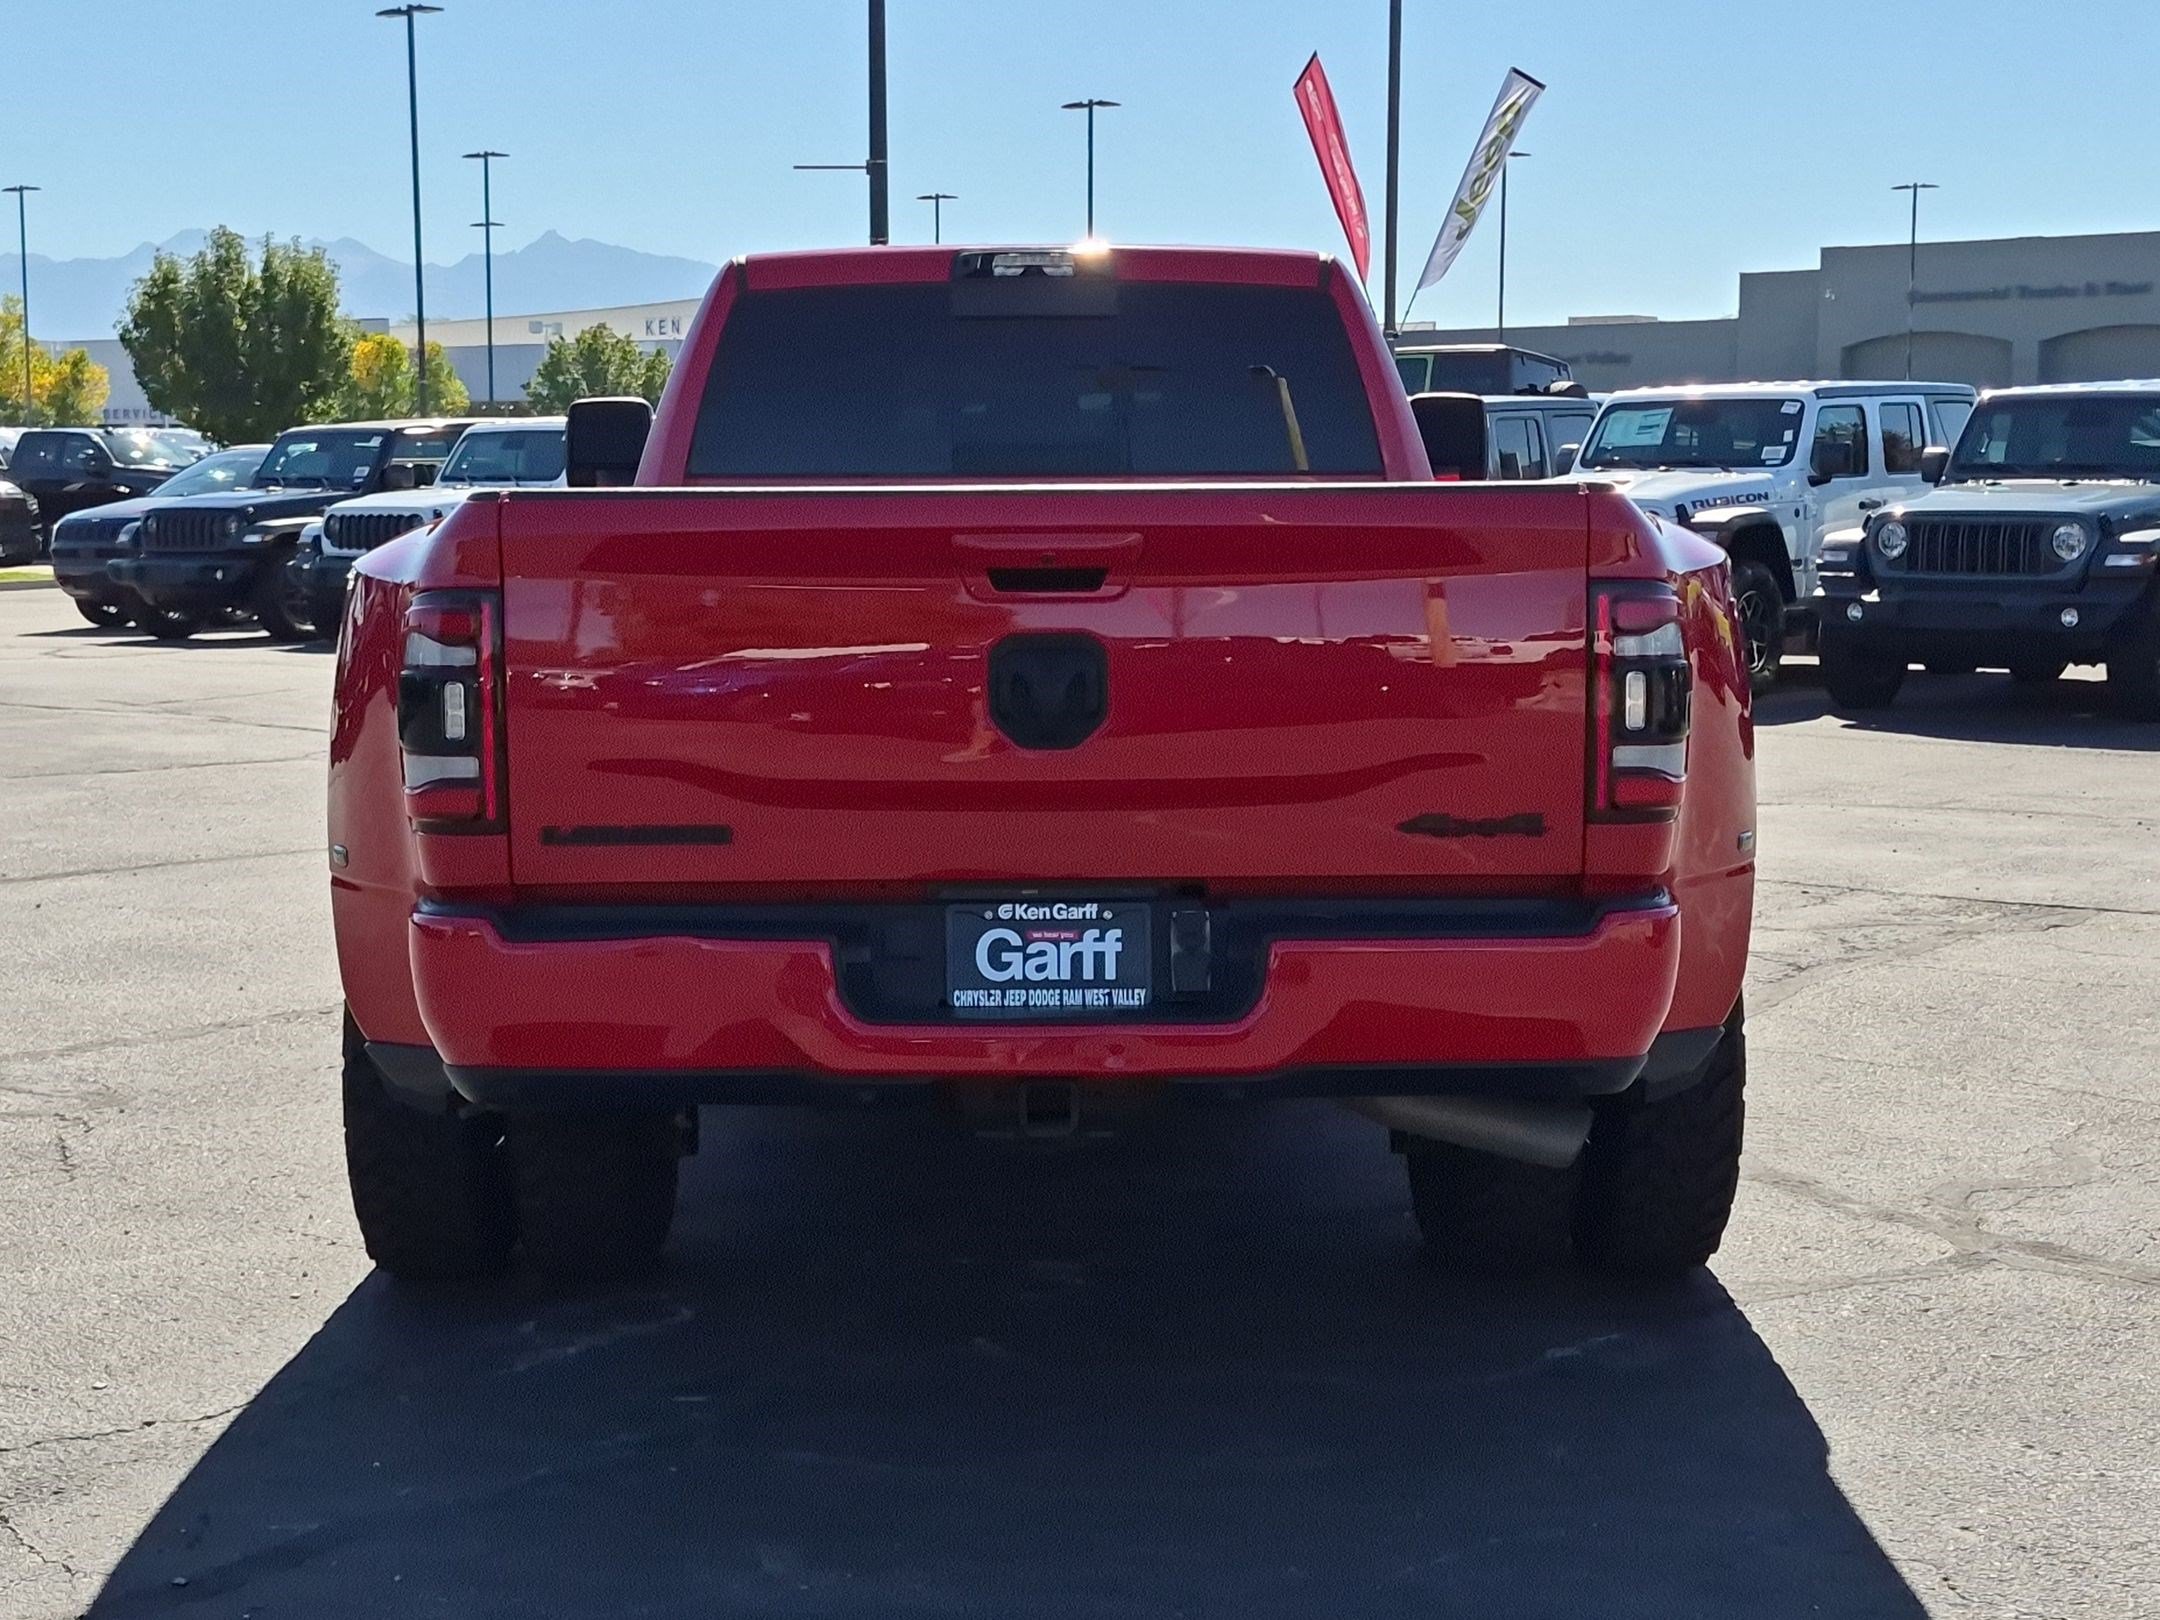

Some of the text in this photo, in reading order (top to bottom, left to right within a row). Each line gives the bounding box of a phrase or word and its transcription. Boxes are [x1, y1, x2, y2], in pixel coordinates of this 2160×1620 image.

[645, 318, 681, 337] KEN
[103, 408, 166, 420] SERVIC
[1690, 491, 1770, 510] RUBICON
[1015, 903, 1051, 920] Ken
[1053, 903, 1098, 920] Garff
[975, 928, 1122, 982] Garff
[953, 988, 1146, 1007] CHRYSLER JEEP DODGE RAM WEST VALLEY
